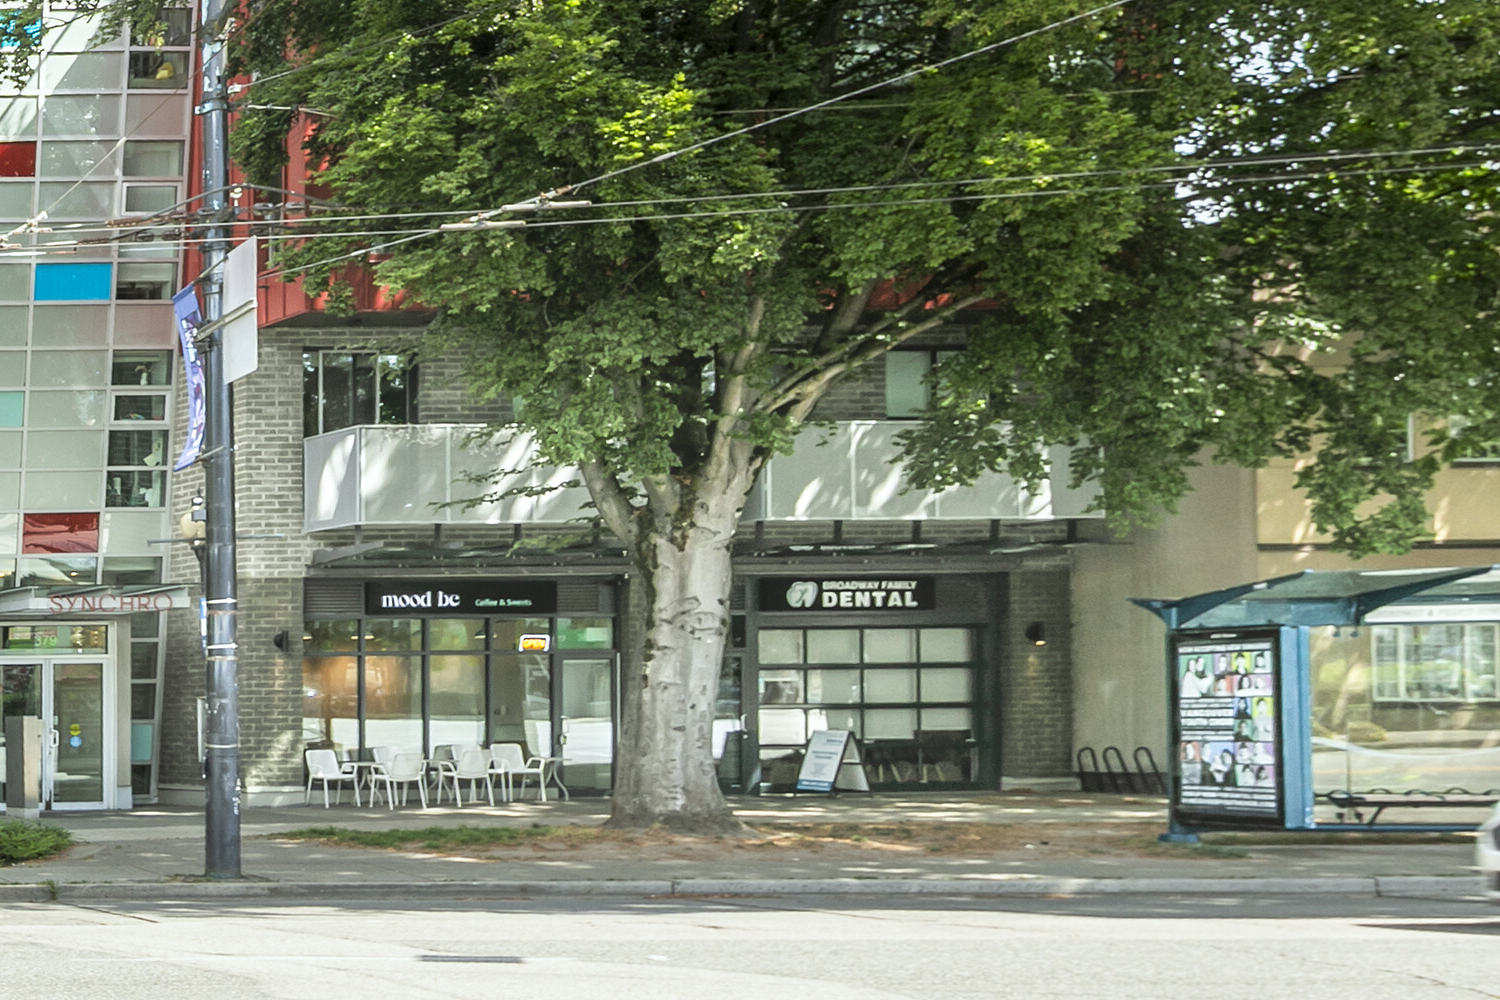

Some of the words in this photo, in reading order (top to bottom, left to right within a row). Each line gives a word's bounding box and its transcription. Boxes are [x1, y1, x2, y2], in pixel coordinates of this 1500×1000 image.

[822, 580, 880, 590] BROADWAY
[881, 580, 917, 590] FAMILY
[50, 593, 172, 613] SYNCHRO
[381, 591, 432, 608] mood
[822, 591, 919, 608] DENTAL
